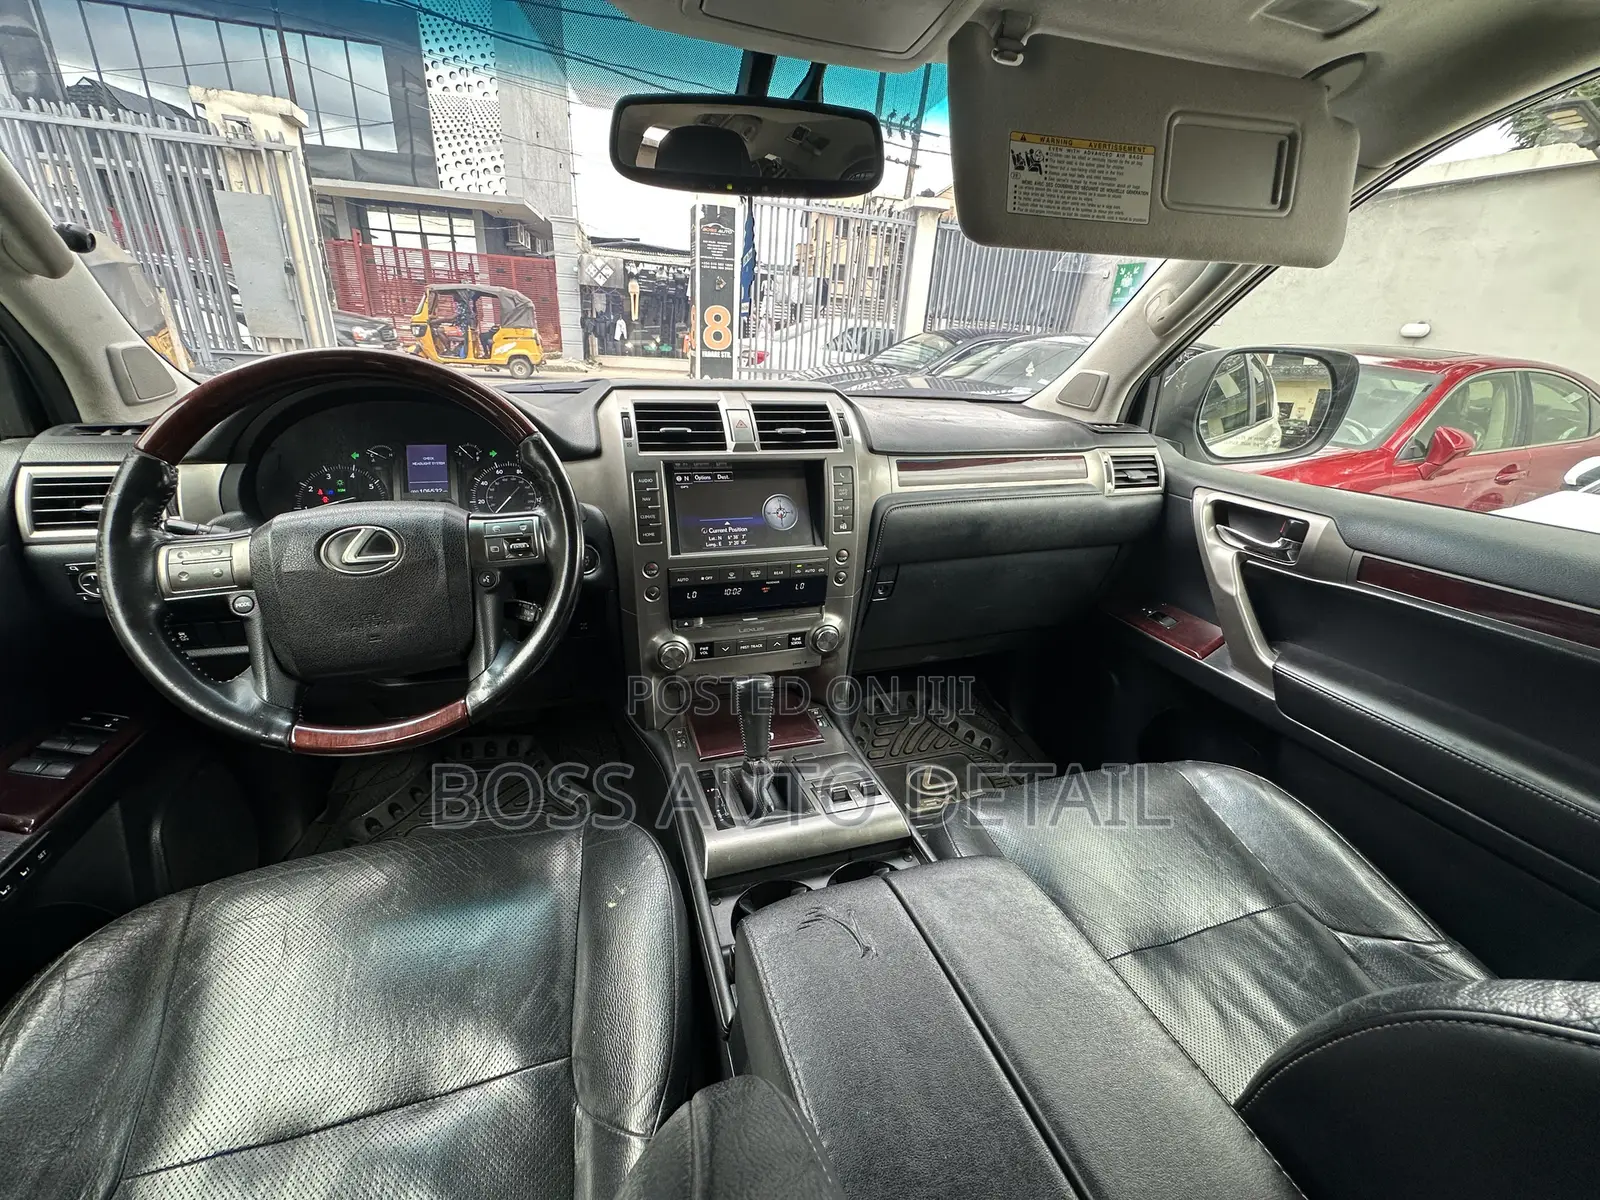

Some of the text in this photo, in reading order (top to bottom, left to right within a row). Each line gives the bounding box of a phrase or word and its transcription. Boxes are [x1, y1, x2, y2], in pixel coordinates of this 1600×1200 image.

[1040, 137, 1146, 153] WARNING AVERTISSEMENT
[1084, 150, 1112, 158] ADVANCED
[702, 304, 732, 351] 8
[723, 587, 742, 596] 10:02
[37, 849, 47, 861] SET
